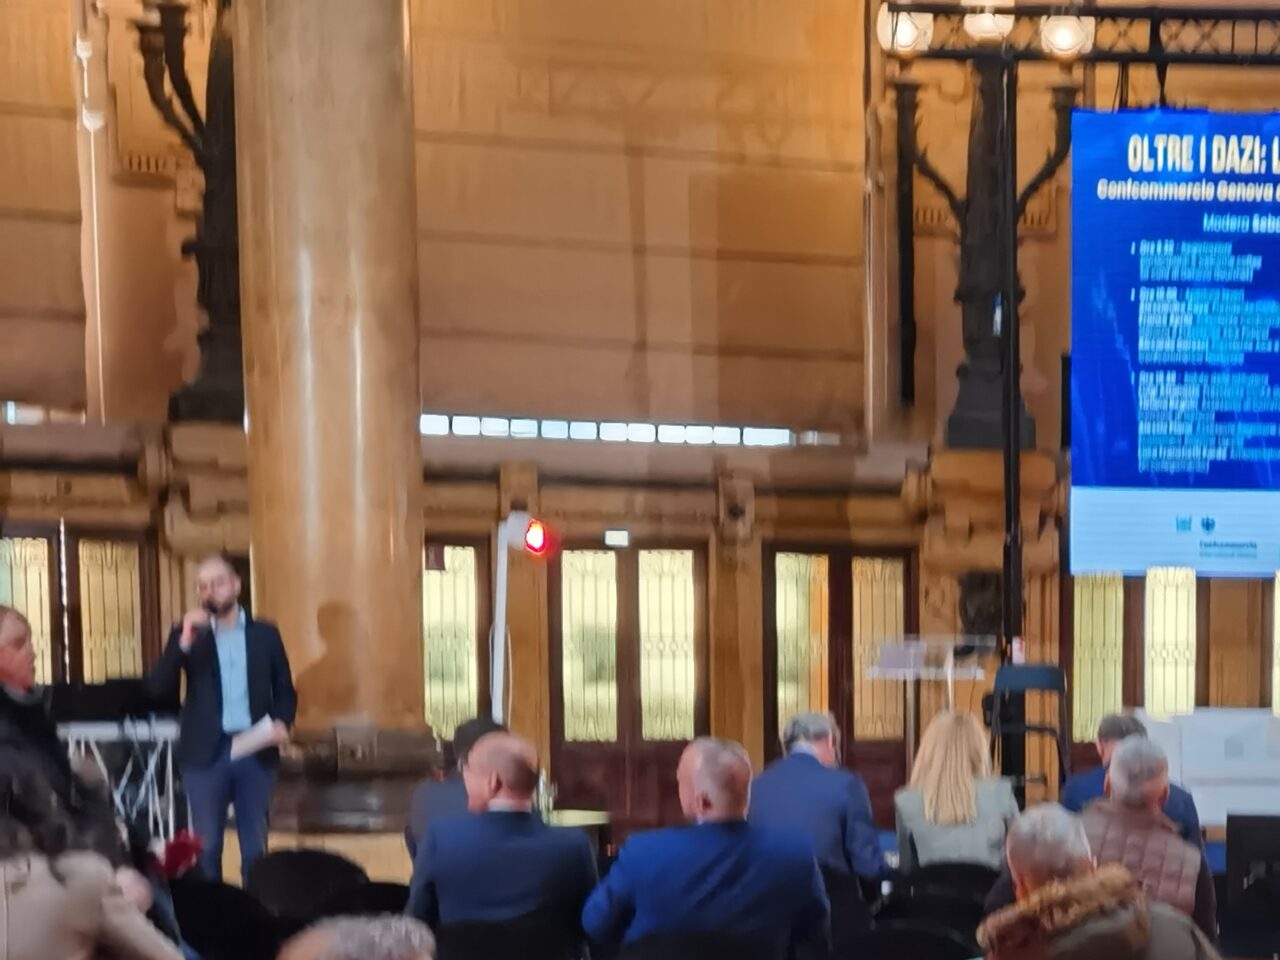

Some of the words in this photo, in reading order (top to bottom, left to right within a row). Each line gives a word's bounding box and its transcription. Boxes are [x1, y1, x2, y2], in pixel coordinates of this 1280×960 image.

[1127, 133, 1194, 172] OLTRE
[1199, 135, 1207, 172] I
[1211, 135, 1267, 174] DAZI:
[1216, 180, 1273, 202] Genova
